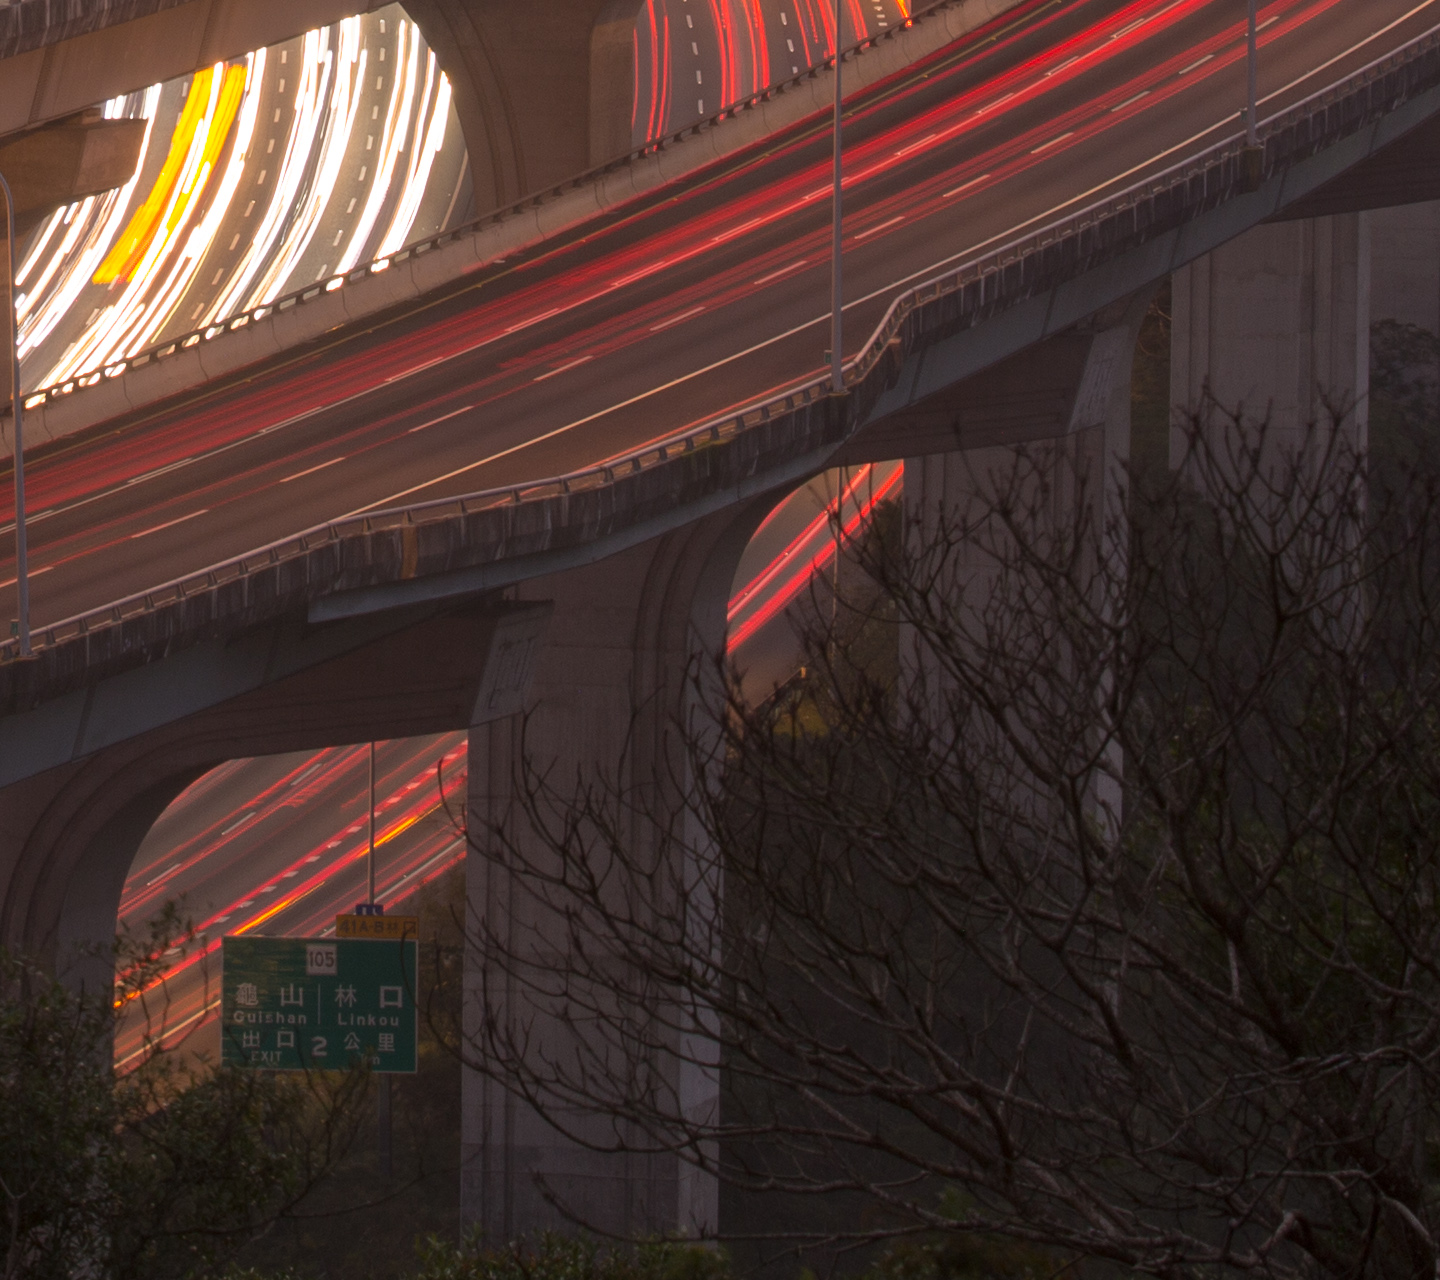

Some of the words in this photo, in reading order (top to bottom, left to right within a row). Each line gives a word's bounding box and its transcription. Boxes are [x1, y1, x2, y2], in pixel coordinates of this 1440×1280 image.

[309, 951, 335, 968] 105
[235, 982, 304, 1007] 龜山
[334, 984, 403, 1008] 林口
[233, 1011, 307, 1025] Guishan
[337, 1012, 399, 1026] Linkou
[242, 1030, 294, 1048] 出口
[311, 1036, 328, 1057] 2
[344, 1031, 395, 1052] 公里
[251, 1050, 282, 1062] EXIT
